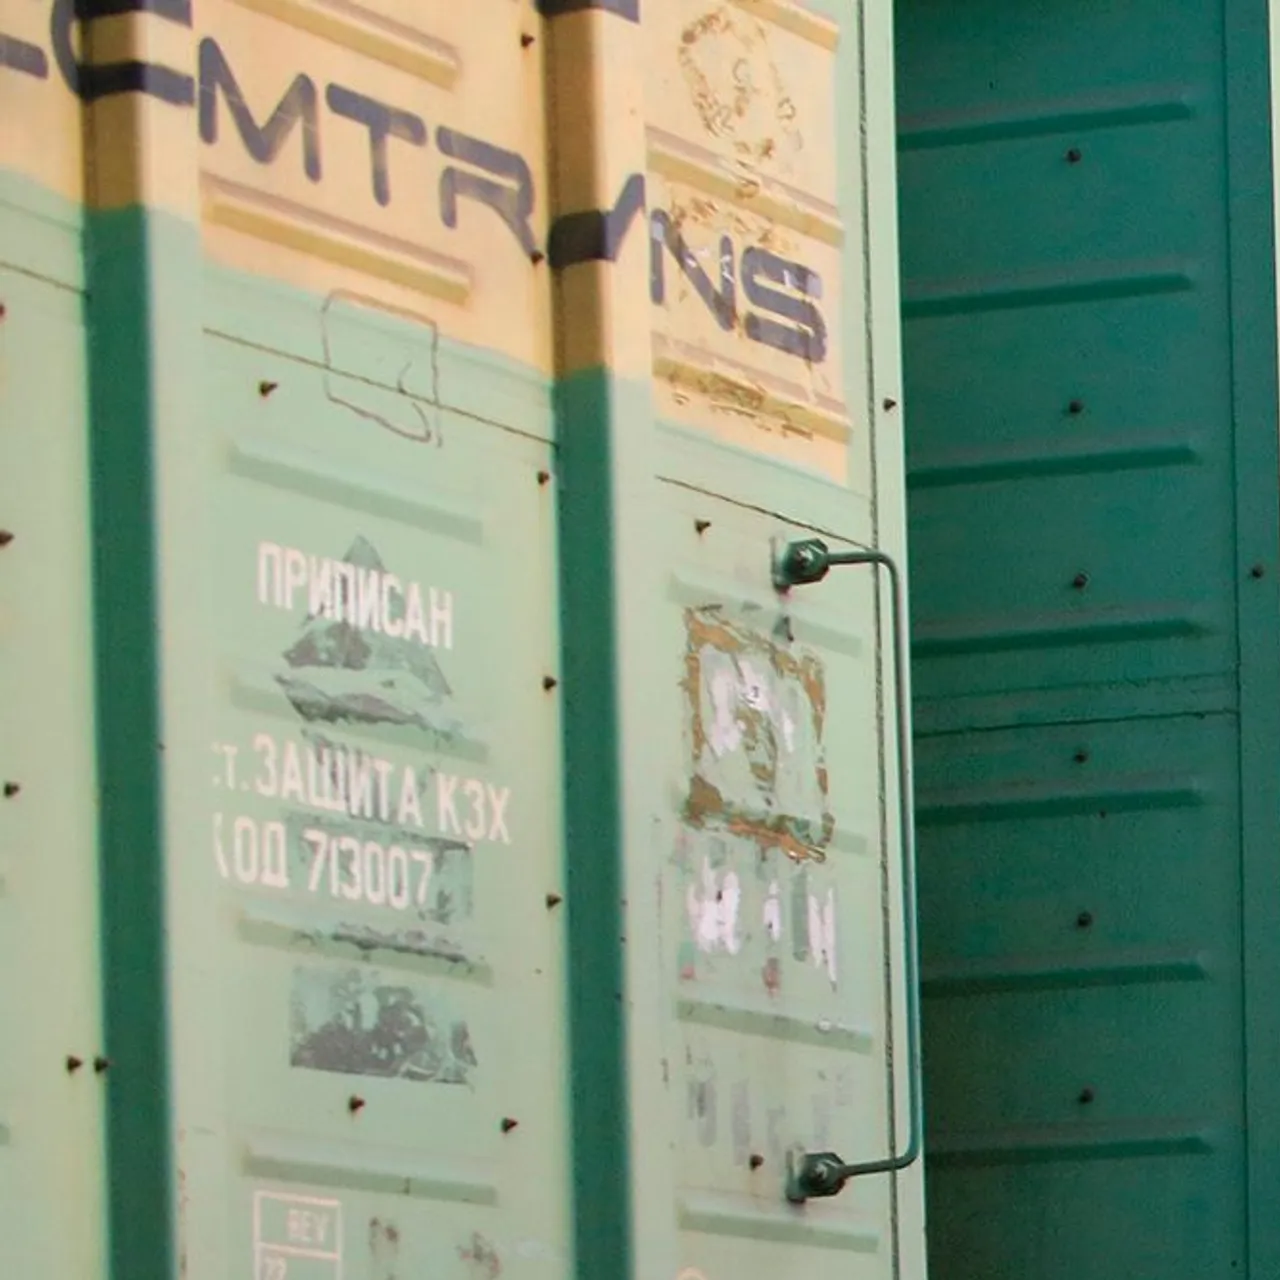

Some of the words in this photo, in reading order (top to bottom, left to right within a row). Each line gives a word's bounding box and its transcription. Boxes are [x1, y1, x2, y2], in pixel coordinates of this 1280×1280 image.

[257, 540, 455, 650] ПРИПИСАН
[436, 770, 513, 846] КЗХ
[303, 826, 435, 911] 713007
